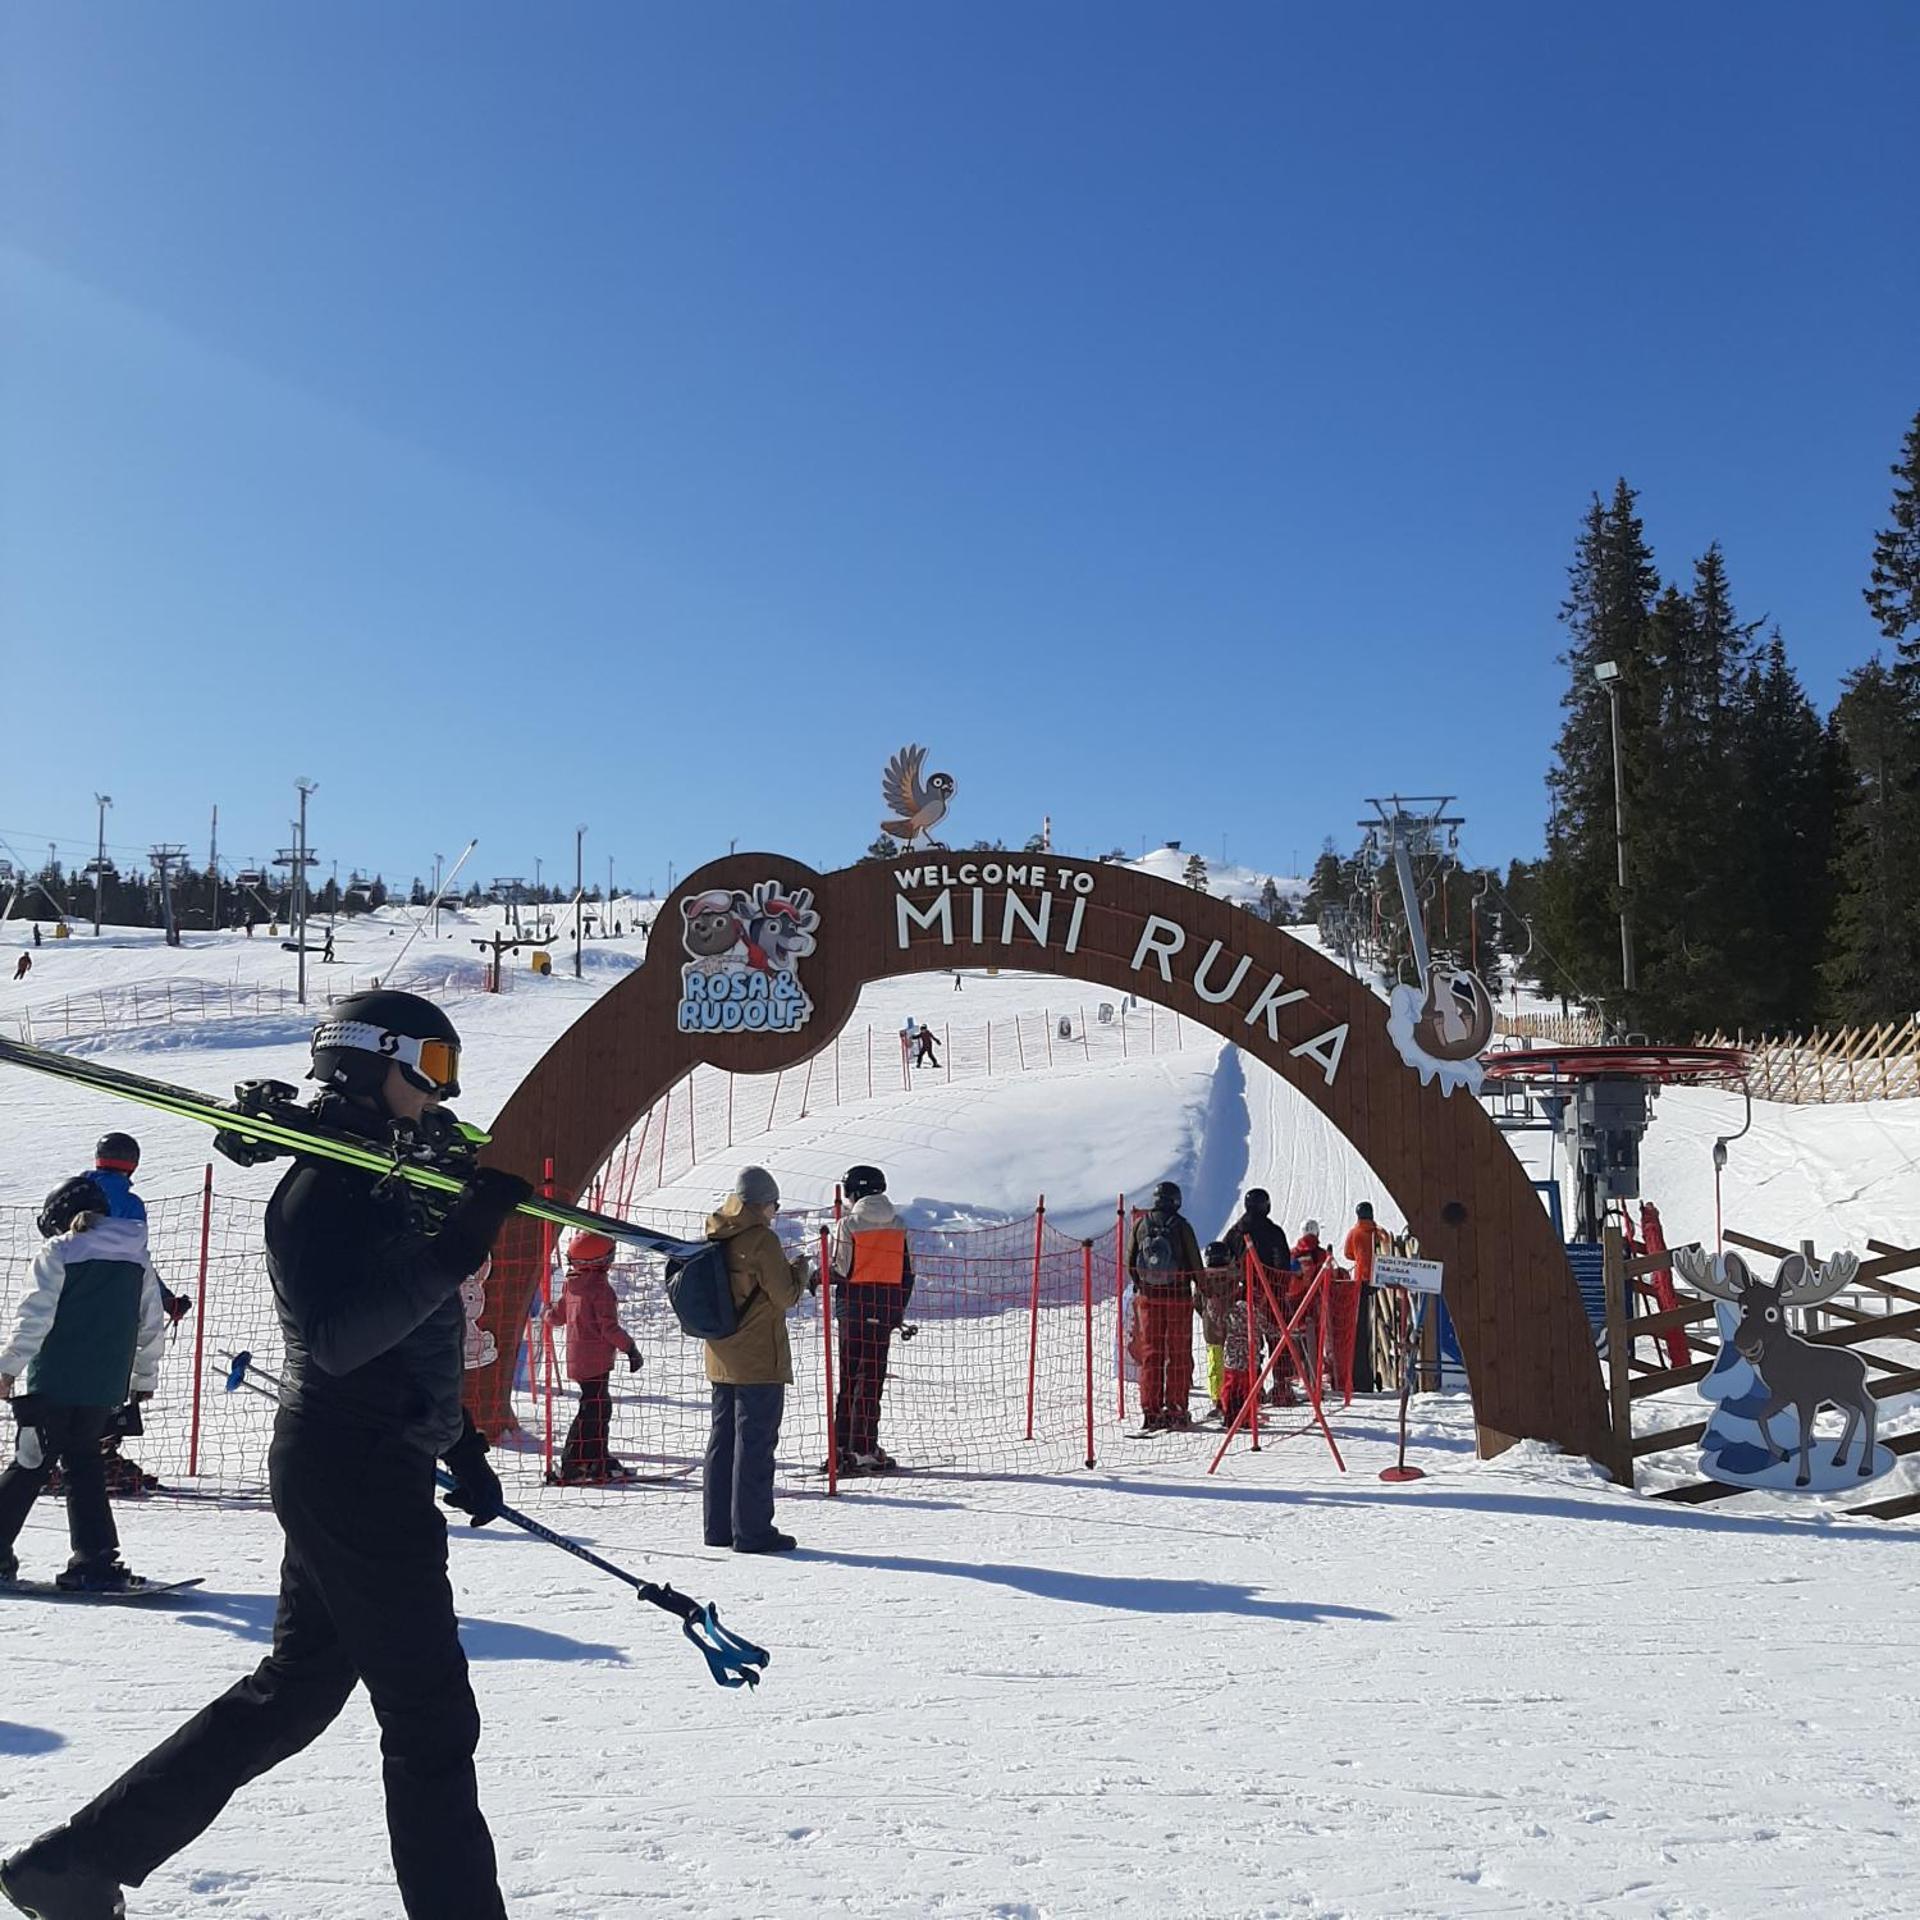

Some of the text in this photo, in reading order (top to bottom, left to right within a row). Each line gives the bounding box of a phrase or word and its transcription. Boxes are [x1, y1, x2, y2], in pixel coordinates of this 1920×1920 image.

[894, 863, 1094, 894] WELCOME TO
[687, 970, 802, 1000] ROSA &
[895, 887, 1349, 1086] MINI RUKA
[681, 1001, 806, 1030] RUDOLF
